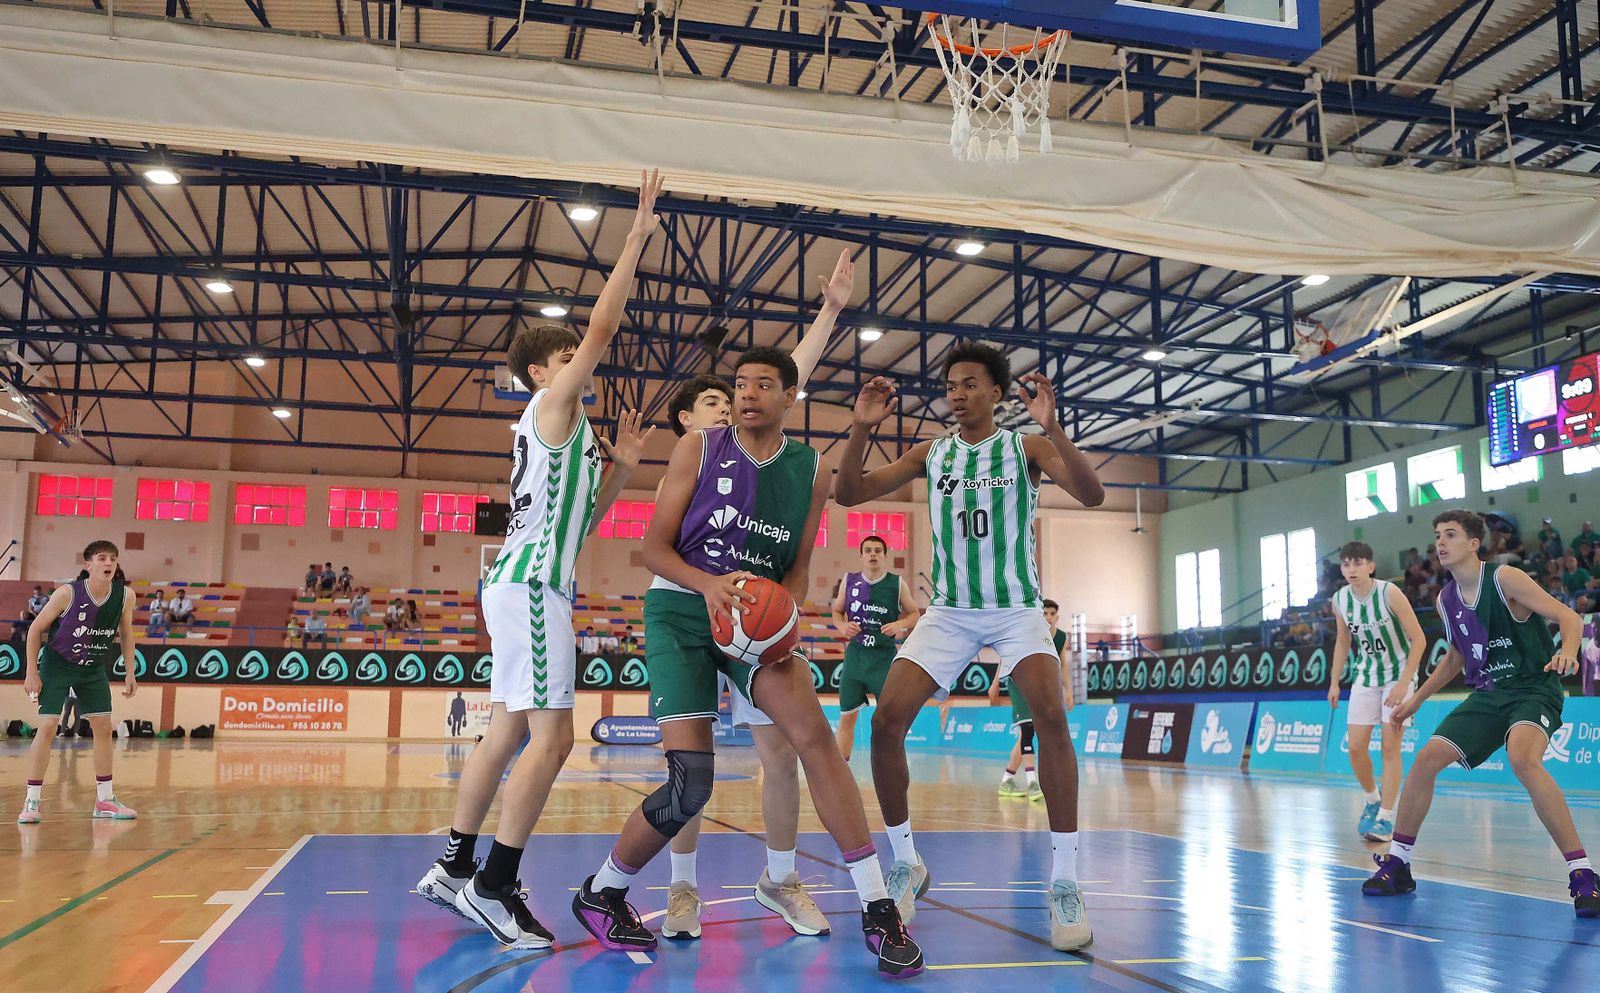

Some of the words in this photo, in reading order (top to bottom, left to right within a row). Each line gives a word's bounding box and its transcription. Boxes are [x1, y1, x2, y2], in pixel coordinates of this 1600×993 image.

[963, 477, 1014, 490] XoyTicket
[736, 514, 791, 544] Unicaja
[957, 508, 989, 539] 10
[1361, 638, 1387, 655] 24
[224, 696, 258, 712] Don
[263, 697, 344, 713] Domicilio
[467, 701, 478, 711] La
[310, 721, 319, 729] 10
[610, 724, 660, 732] Ayuntamiento
[1578, 722, 1600, 742] Dip
[1575, 747, 1592, 764] de
